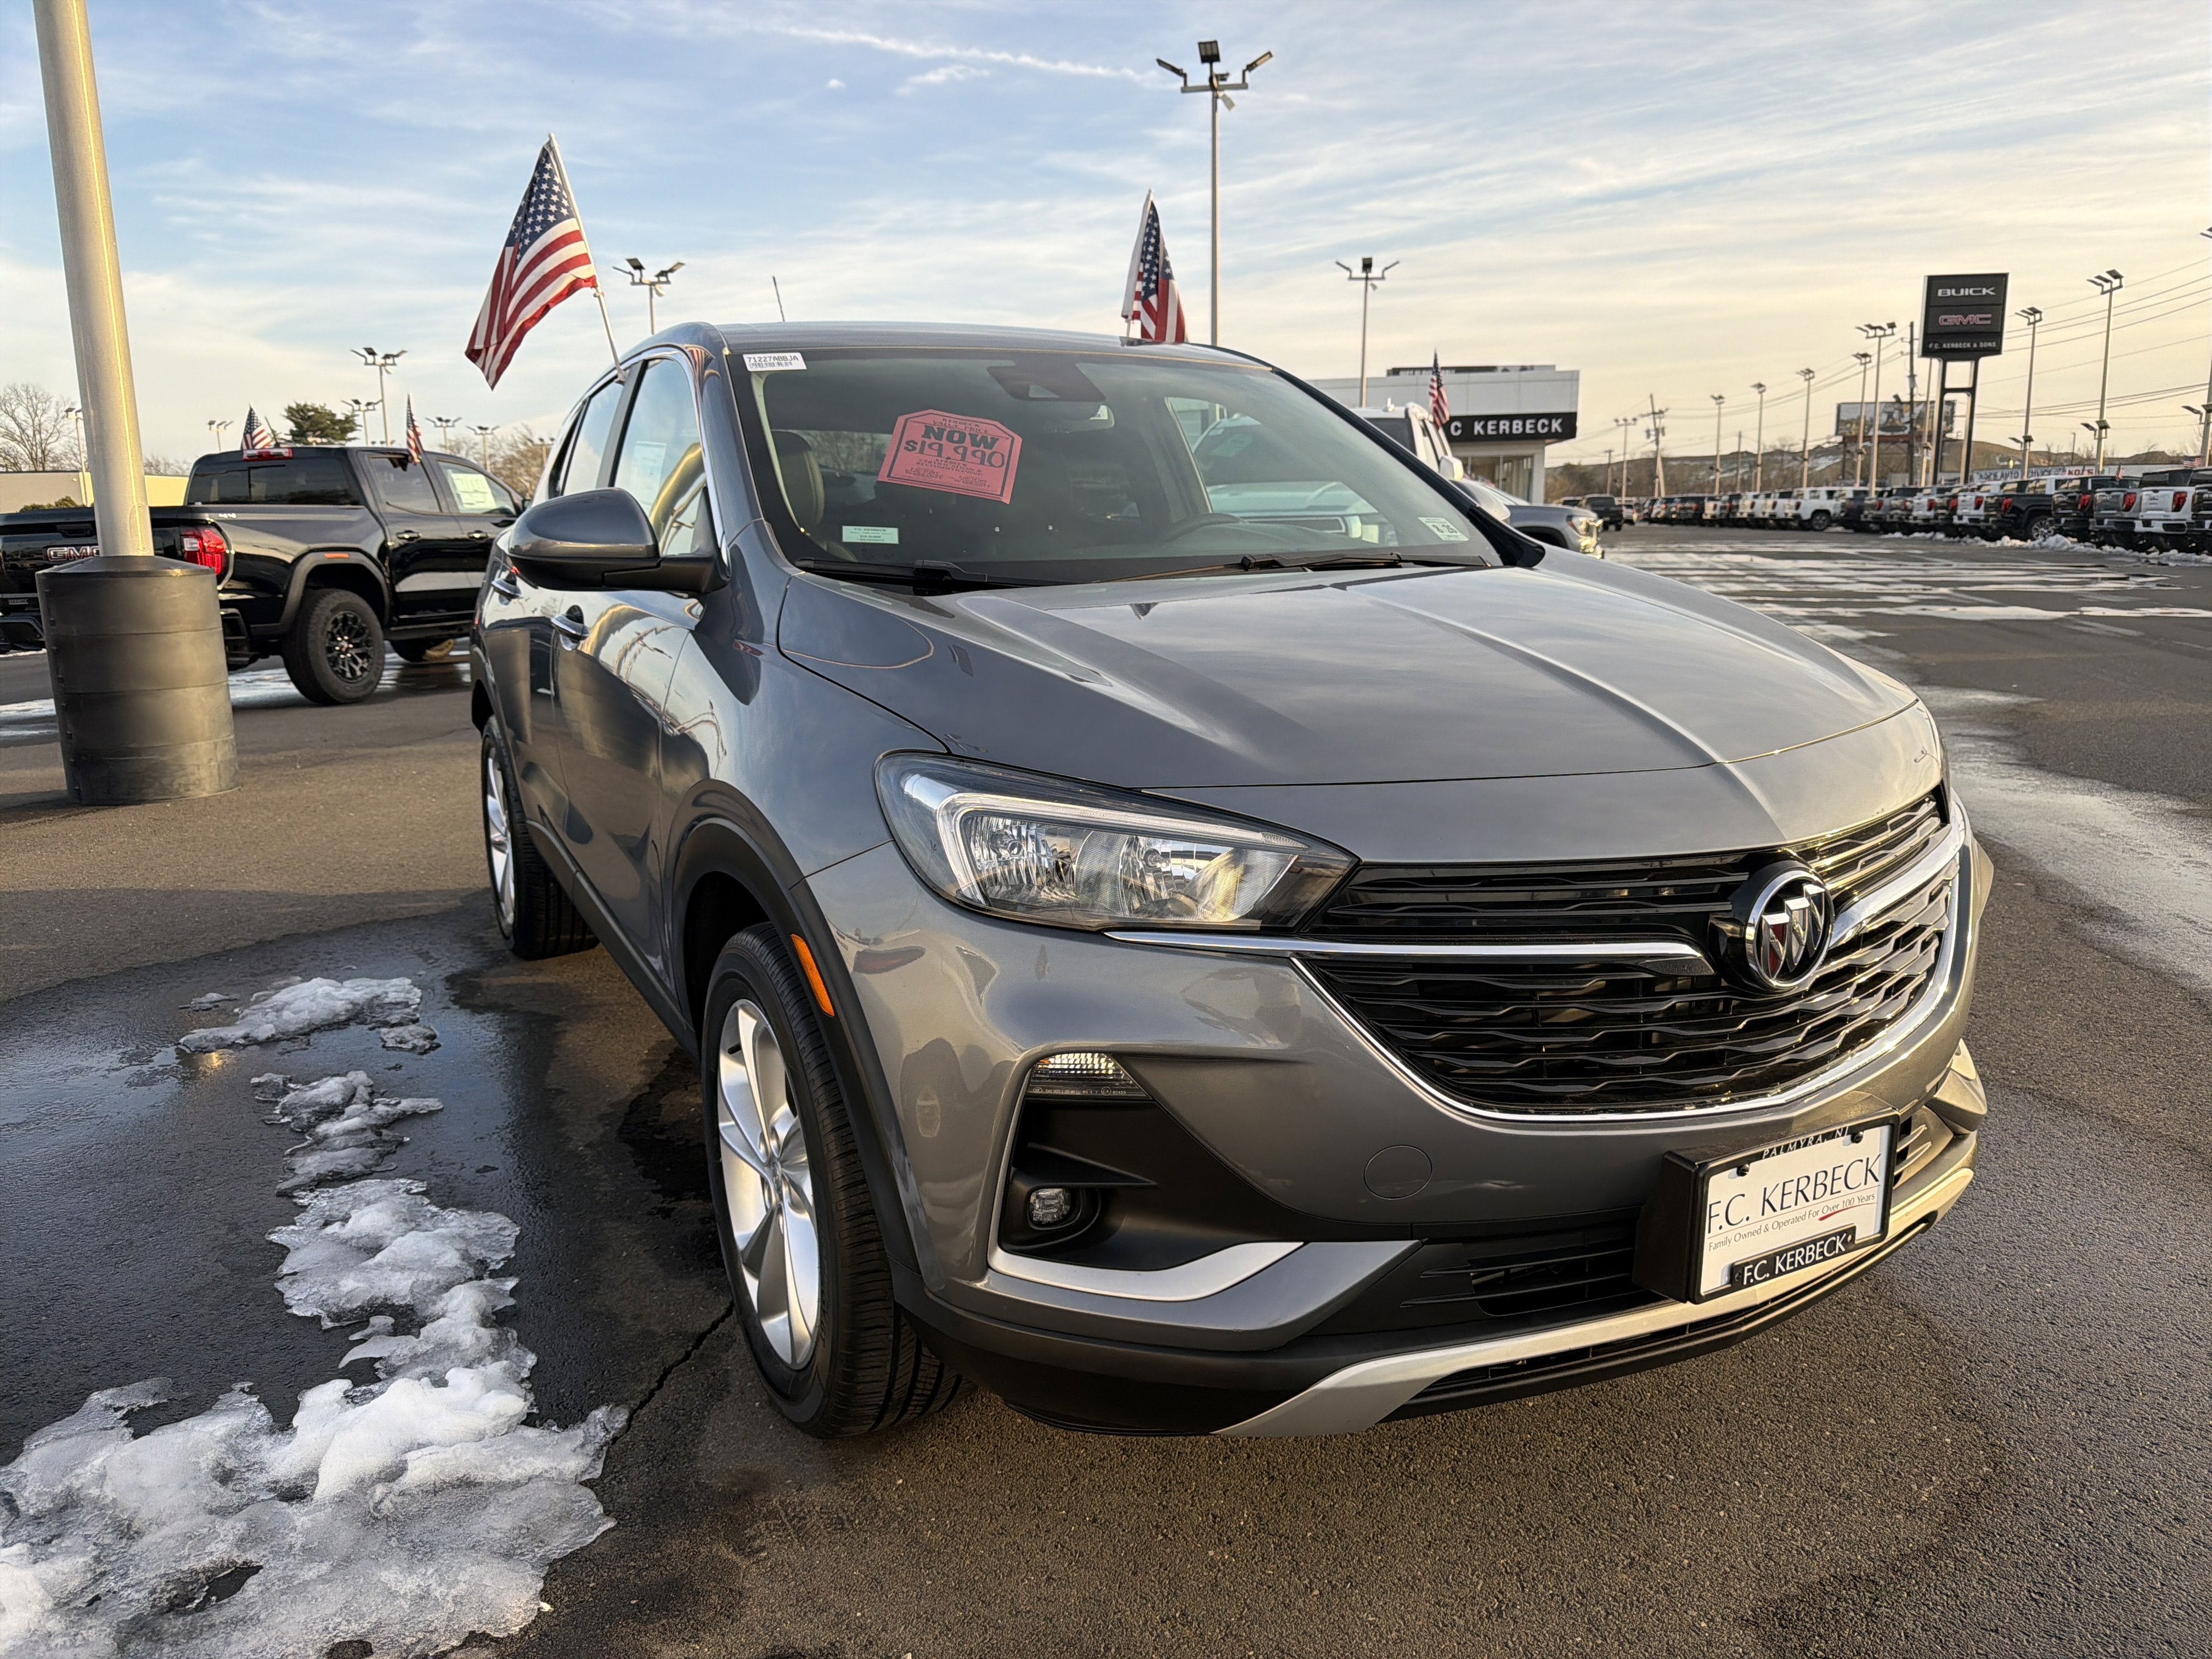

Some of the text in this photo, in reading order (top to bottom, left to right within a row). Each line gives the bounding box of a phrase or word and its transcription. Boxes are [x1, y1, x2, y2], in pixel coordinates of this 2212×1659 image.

[1938, 287, 1996, 296] BUICK
[1939, 314, 1992, 325] GMC
[922, 425, 999, 450] NOW
[1474, 417, 1562, 436] KERBECK
[1762, 1134, 1827, 1160] PALMYRA,
[1707, 1154, 1881, 1234] F.C. KERBECK
[1709, 1193, 1875, 1252] Family Owned & Operated For Over 100 Years
[1743, 1233, 1847, 1285] F.C. KERBECK
